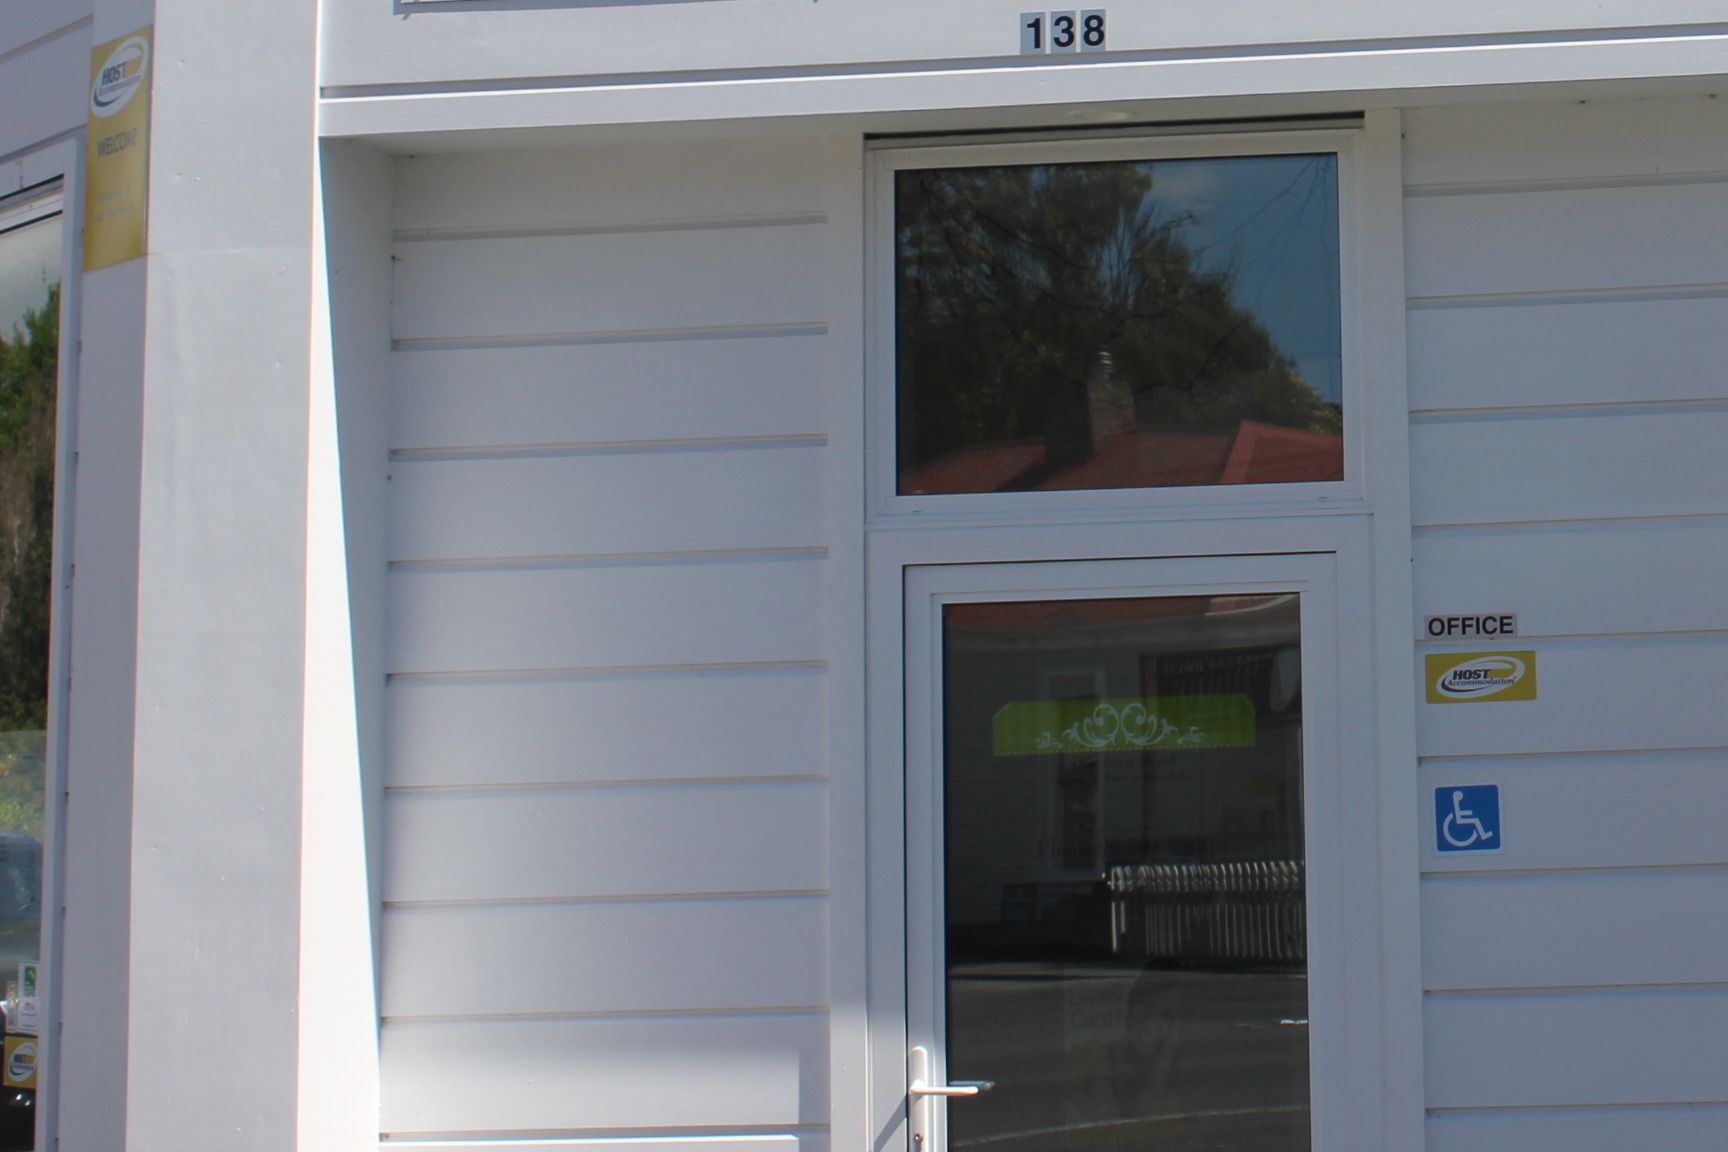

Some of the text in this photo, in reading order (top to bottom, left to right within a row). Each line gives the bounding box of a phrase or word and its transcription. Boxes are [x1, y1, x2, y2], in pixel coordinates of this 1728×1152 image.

[1026, 14, 1105, 49] 138
[1428, 615, 1514, 636] OFFICE
[1453, 669, 1491, 680] HOST
